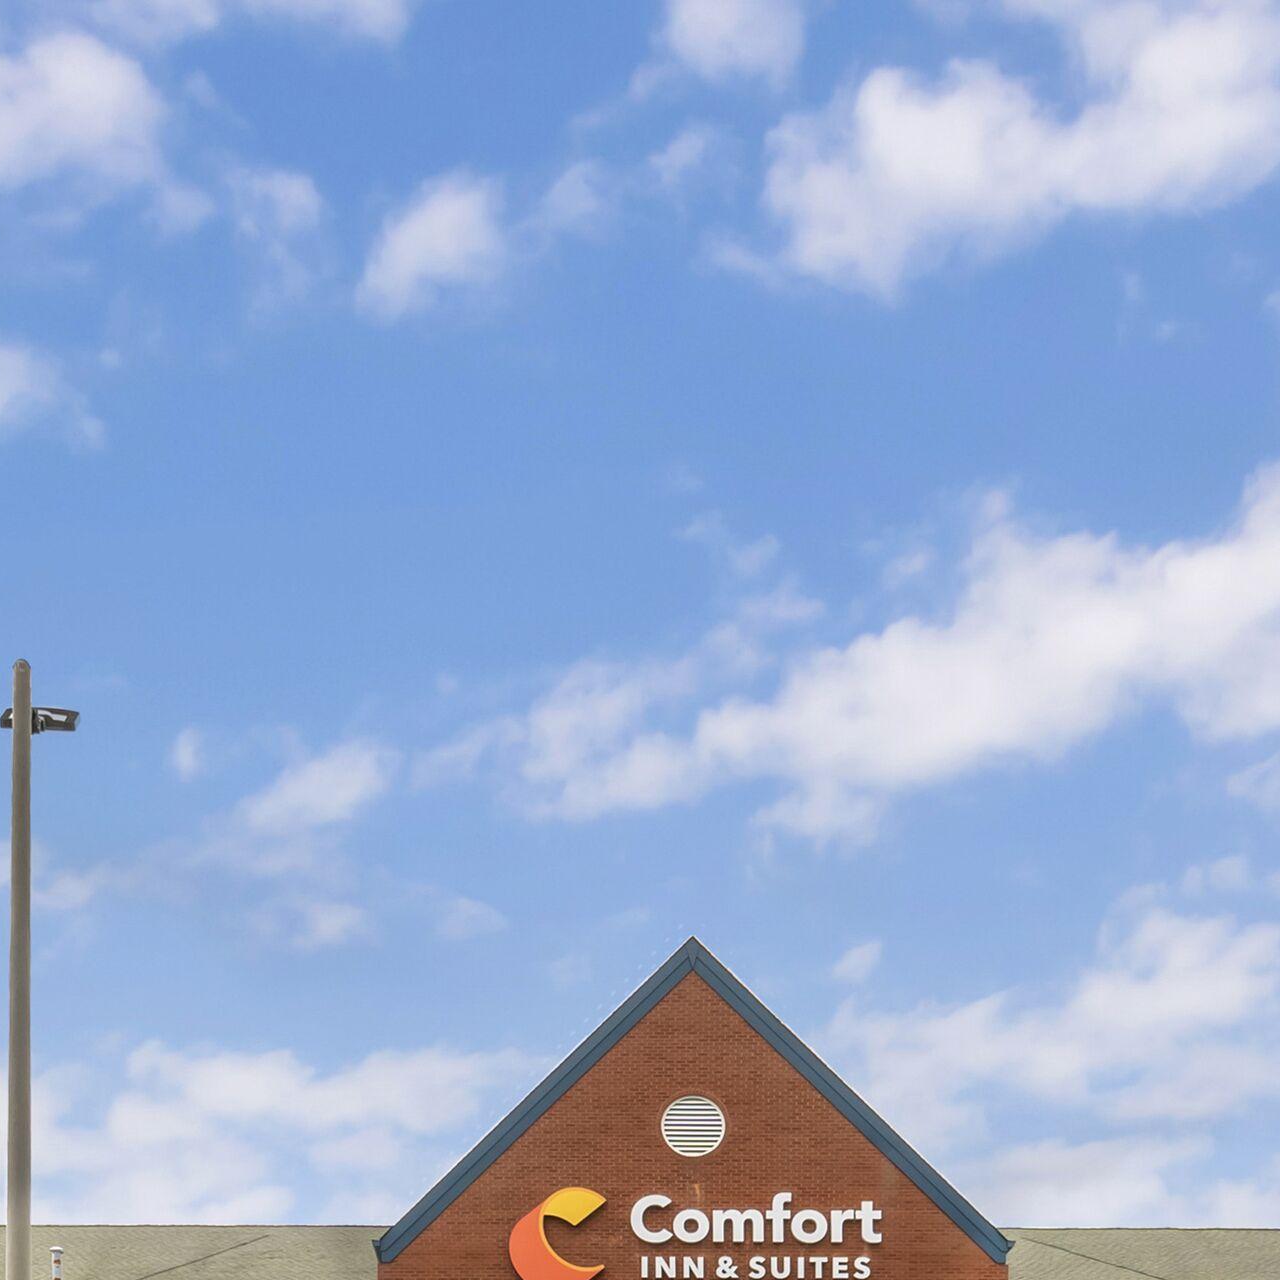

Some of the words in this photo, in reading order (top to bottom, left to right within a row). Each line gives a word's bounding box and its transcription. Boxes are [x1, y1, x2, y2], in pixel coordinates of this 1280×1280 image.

[630, 1192, 883, 1244] Comfort
[641, 1255, 705, 1279] INN
[715, 1255, 739, 1279] &
[748, 1255, 871, 1280] SUITES
